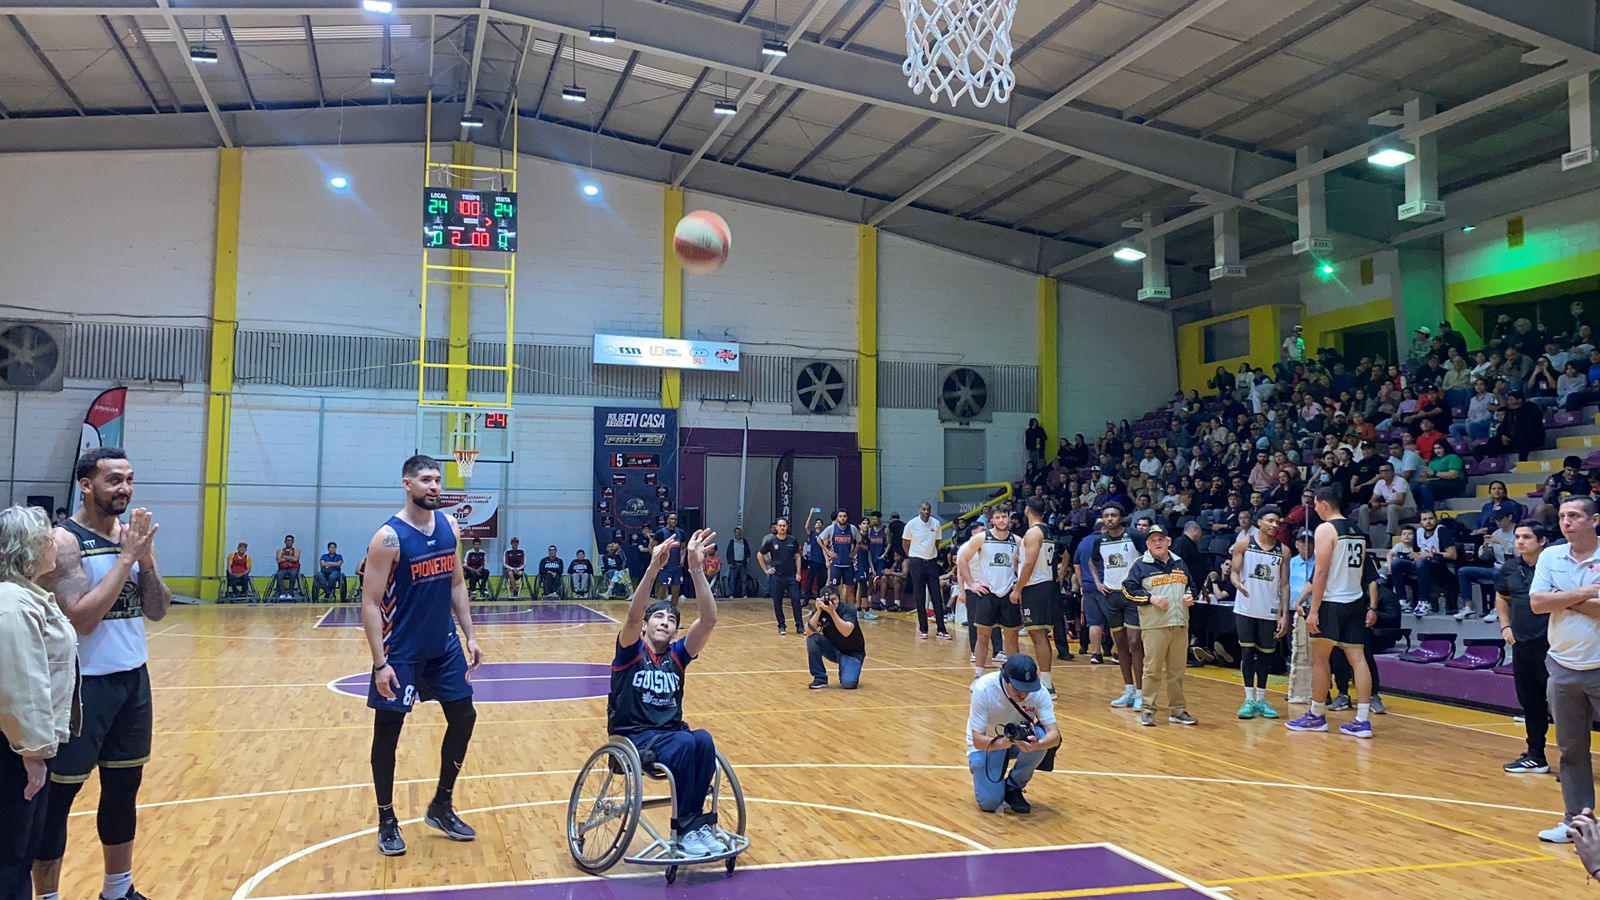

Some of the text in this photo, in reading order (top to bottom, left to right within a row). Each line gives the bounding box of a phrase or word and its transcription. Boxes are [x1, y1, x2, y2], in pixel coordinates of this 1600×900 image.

[428, 200, 448, 214] 24
[494, 203, 513, 218] 24
[452, 231, 460, 246] 2
[487, 412, 505, 427] 24
[624, 413, 666, 428] EN CASA
[616, 453, 623, 467] 5
[1124, 544, 1128, 552] 4
[1348, 544, 1362, 568] 23
